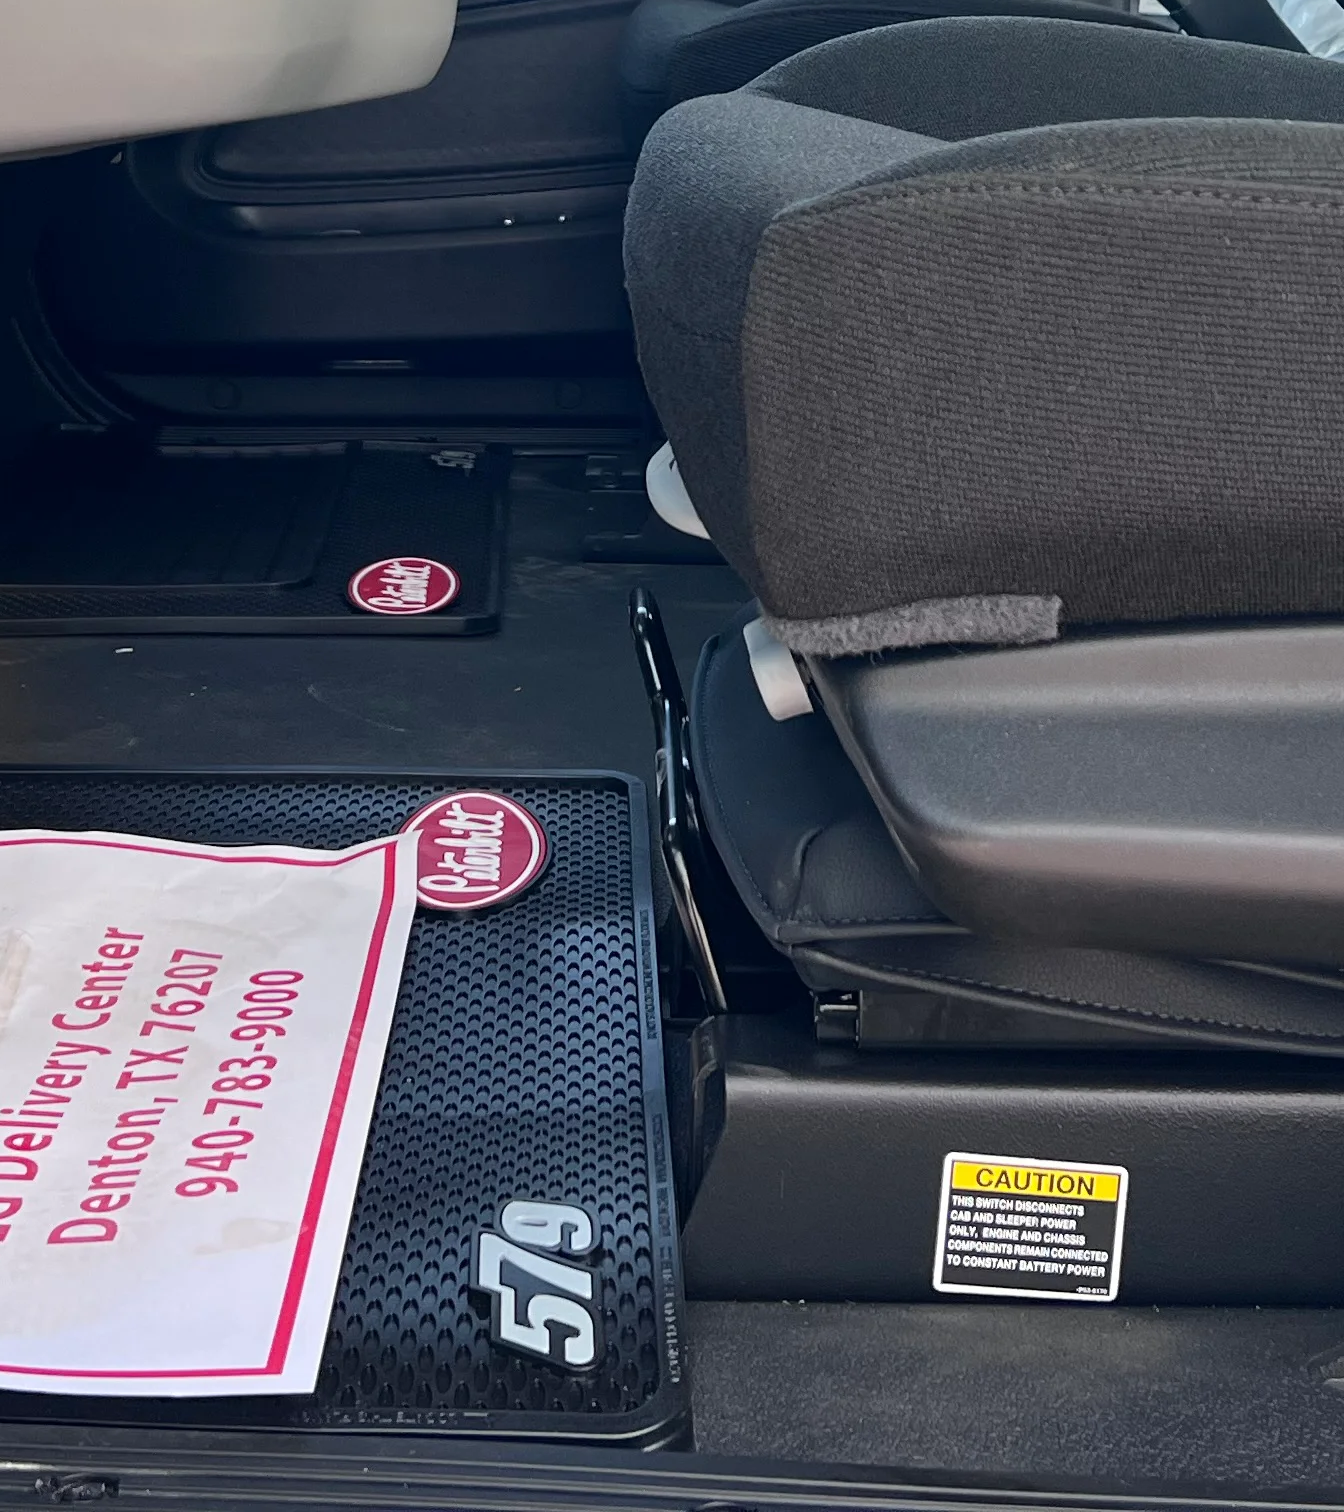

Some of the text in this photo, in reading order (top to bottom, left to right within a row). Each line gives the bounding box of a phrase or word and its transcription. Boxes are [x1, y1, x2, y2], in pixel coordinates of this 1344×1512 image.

[368, 562, 433, 609] Peterbilt
[418, 801, 507, 897] Peterbilt
[52, 927, 144, 1031] Center
[46, 949, 224, 1245] Denton, TX 76207
[175, 971, 304, 1198] 940-783-9000
[976, 1169, 1095, 1196] CAUTION
[950, 1210, 1077, 1230] CAB AND SLEEPER POWER
[951, 1195, 1085, 1217] THIS SWITCH DISCONNECTS
[947, 1239, 1109, 1263] COMPONENTS REMAIN CONNECTED
[982, 1228, 1019, 1241] ENGINE
[1021, 1230, 1042, 1242] AND
[1043, 1232, 1086, 1246] CHASSIS
[947, 1254, 1106, 1278] TO CONSTANT BATTERY POWER
[477, 1207, 599, 1367] 579
